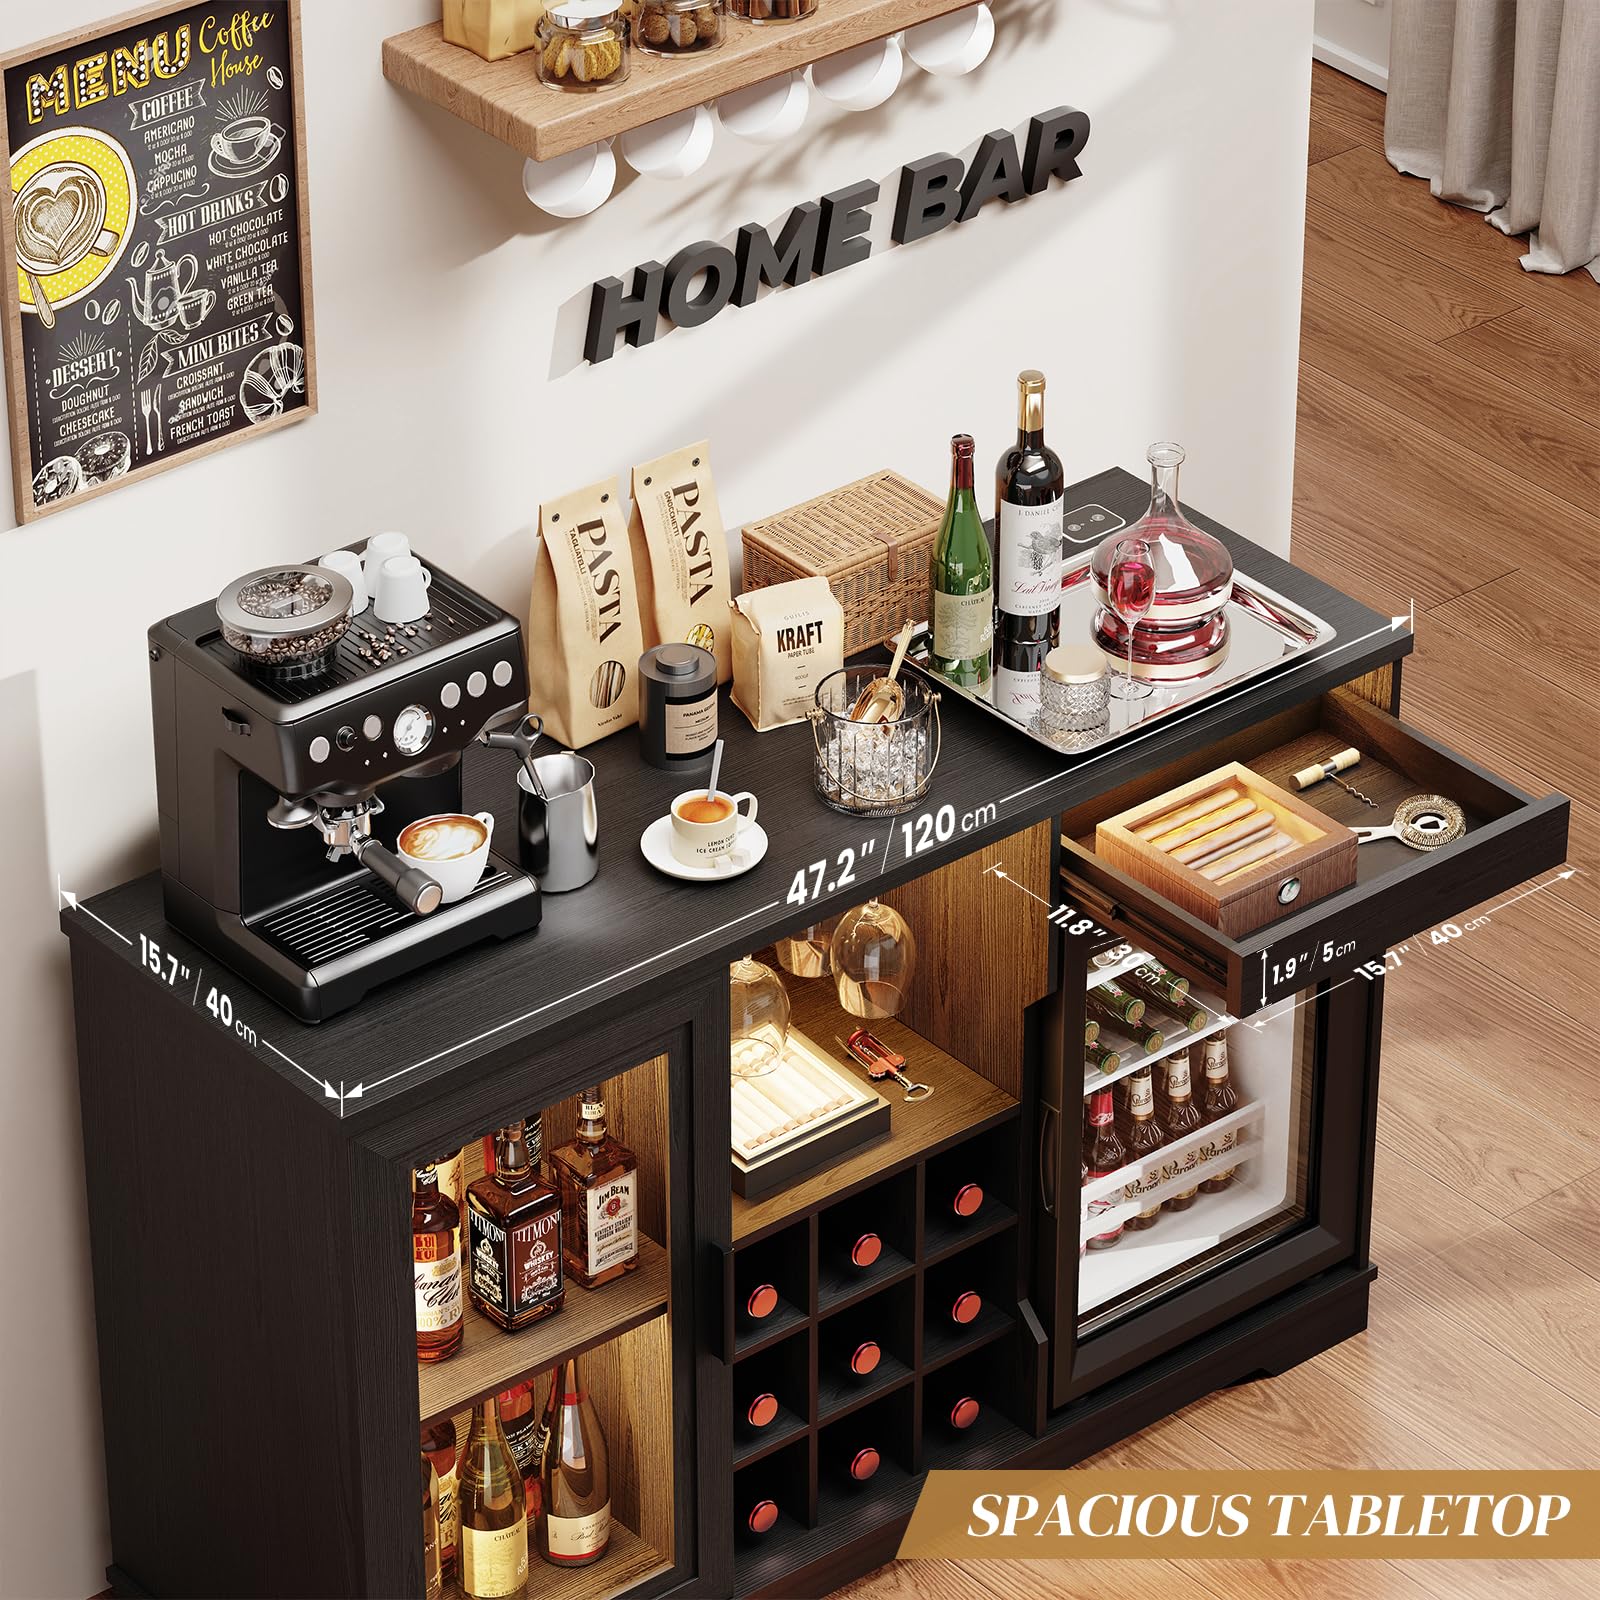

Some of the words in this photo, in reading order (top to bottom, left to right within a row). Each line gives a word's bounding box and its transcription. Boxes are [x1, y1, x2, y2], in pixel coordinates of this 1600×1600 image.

[198, 10, 274, 54] Coffee
[25, 23, 191, 125] MENU
[209, 50, 265, 88] House
[142, 86, 194, 122] COFFEE
[144, 115, 195, 144] AMERICANO
[154, 143, 187, 166] MOCHA
[147, 165, 197, 193] CAPPUCINO
[167, 209, 197, 238] HOT
[200, 190, 254, 226] DRINKS
[208, 228, 228, 246] HOT
[230, 209, 284, 238] CHOCOLATE
[206, 251, 232, 271] WHITE
[235, 231, 288, 260] CHOCOLATE
[584, 178, 880, 365] HOME
[890, 105, 1091, 245] BAR
[220, 266, 258, 289] VANILLA
[260, 258, 277, 275] TEA
[227, 290, 254, 311] GREEN
[256, 283, 273, 299] TEA
[178, 339, 214, 368] MINI
[218, 322, 259, 354] BITES
[52, 347, 116, 388] DESSERT
[176, 361, 224, 389] CROISSANT
[61, 384, 109, 412] DOUGHNUT
[179, 385, 224, 411] SANDWICH
[59, 406, 115, 437] CHEESECAKE
[170, 415, 204, 440] FRENCH
[207, 404, 236, 425] TOAST
[671, 479, 713, 608] PASTA
[576, 516, 621, 644] PASTA
[776, 620, 823, 653] KRAFT
[787, 650, 803, 659] PAPER
[803, 647, 815, 656] TUBE
[596, 1190, 610, 1210] JIM
[610, 1185, 630, 1196] BEAM
[524, 1250, 554, 1270] WHISKEY
